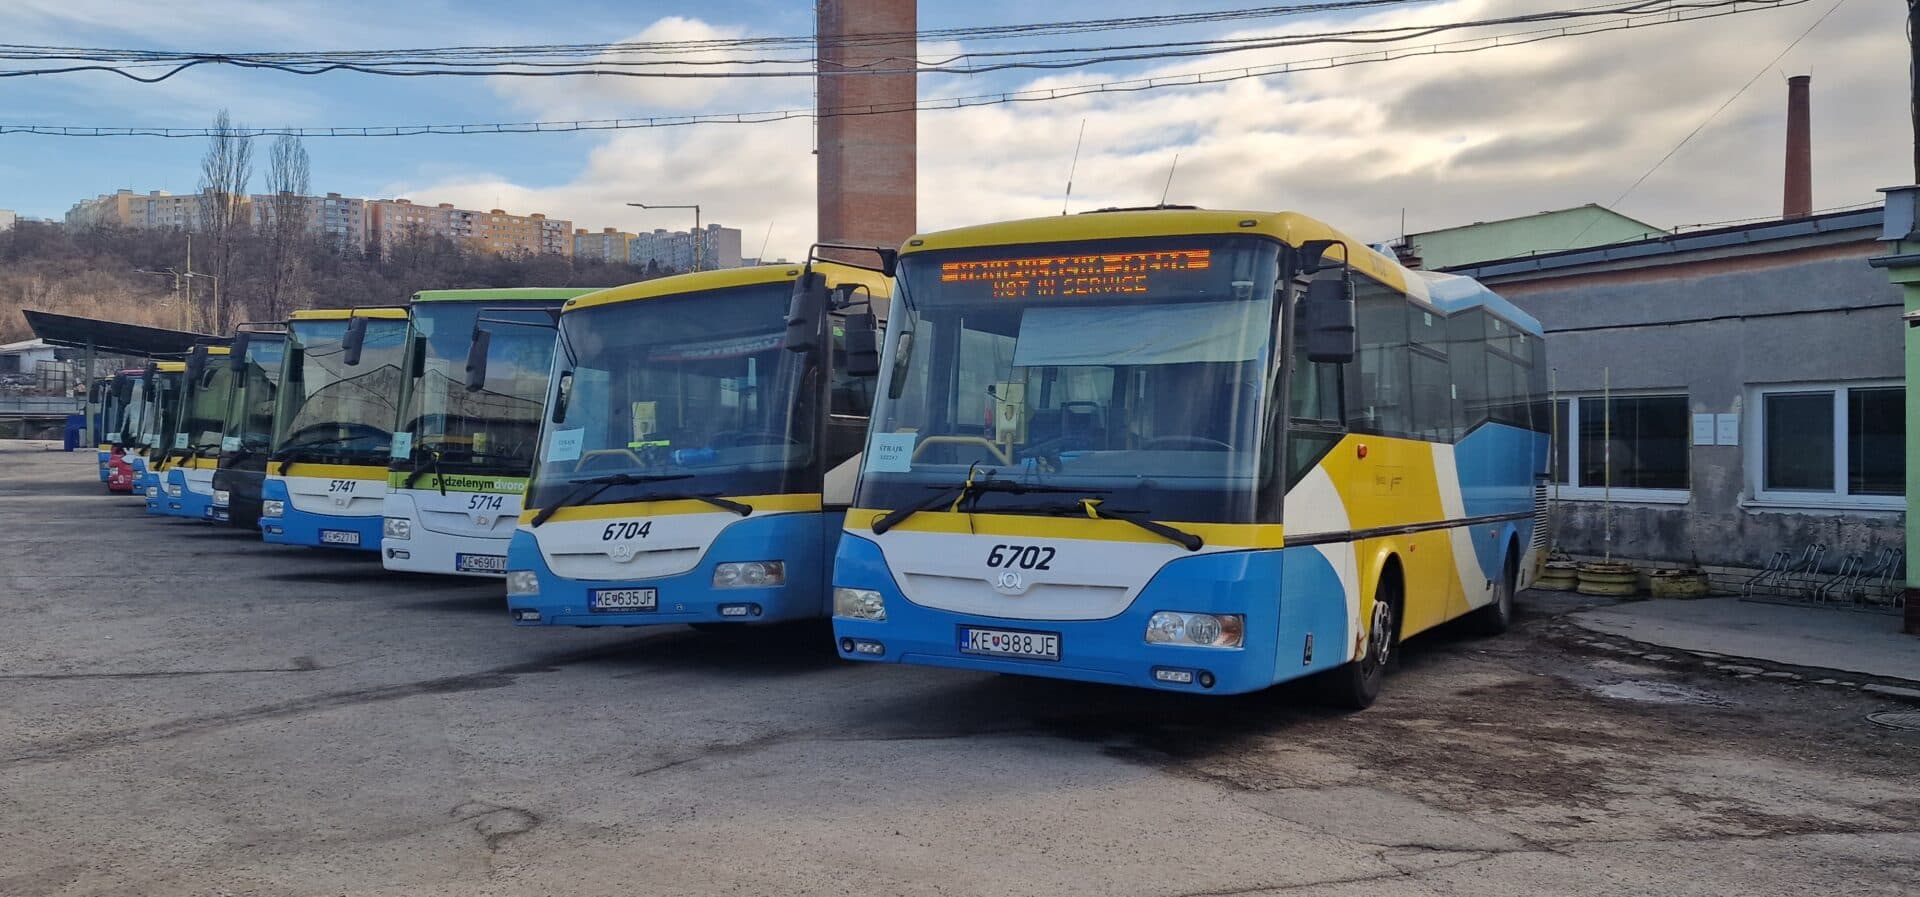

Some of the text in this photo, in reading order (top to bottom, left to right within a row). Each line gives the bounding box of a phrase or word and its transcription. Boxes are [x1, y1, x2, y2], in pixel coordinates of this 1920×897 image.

[992, 280, 1029, 297] NOT
[1063, 275, 1147, 294] SERVICE
[328, 480, 357, 493] 5741
[468, 494, 503, 510] 5714
[602, 521, 652, 541] 6704
[987, 544, 1056, 571] 6702
